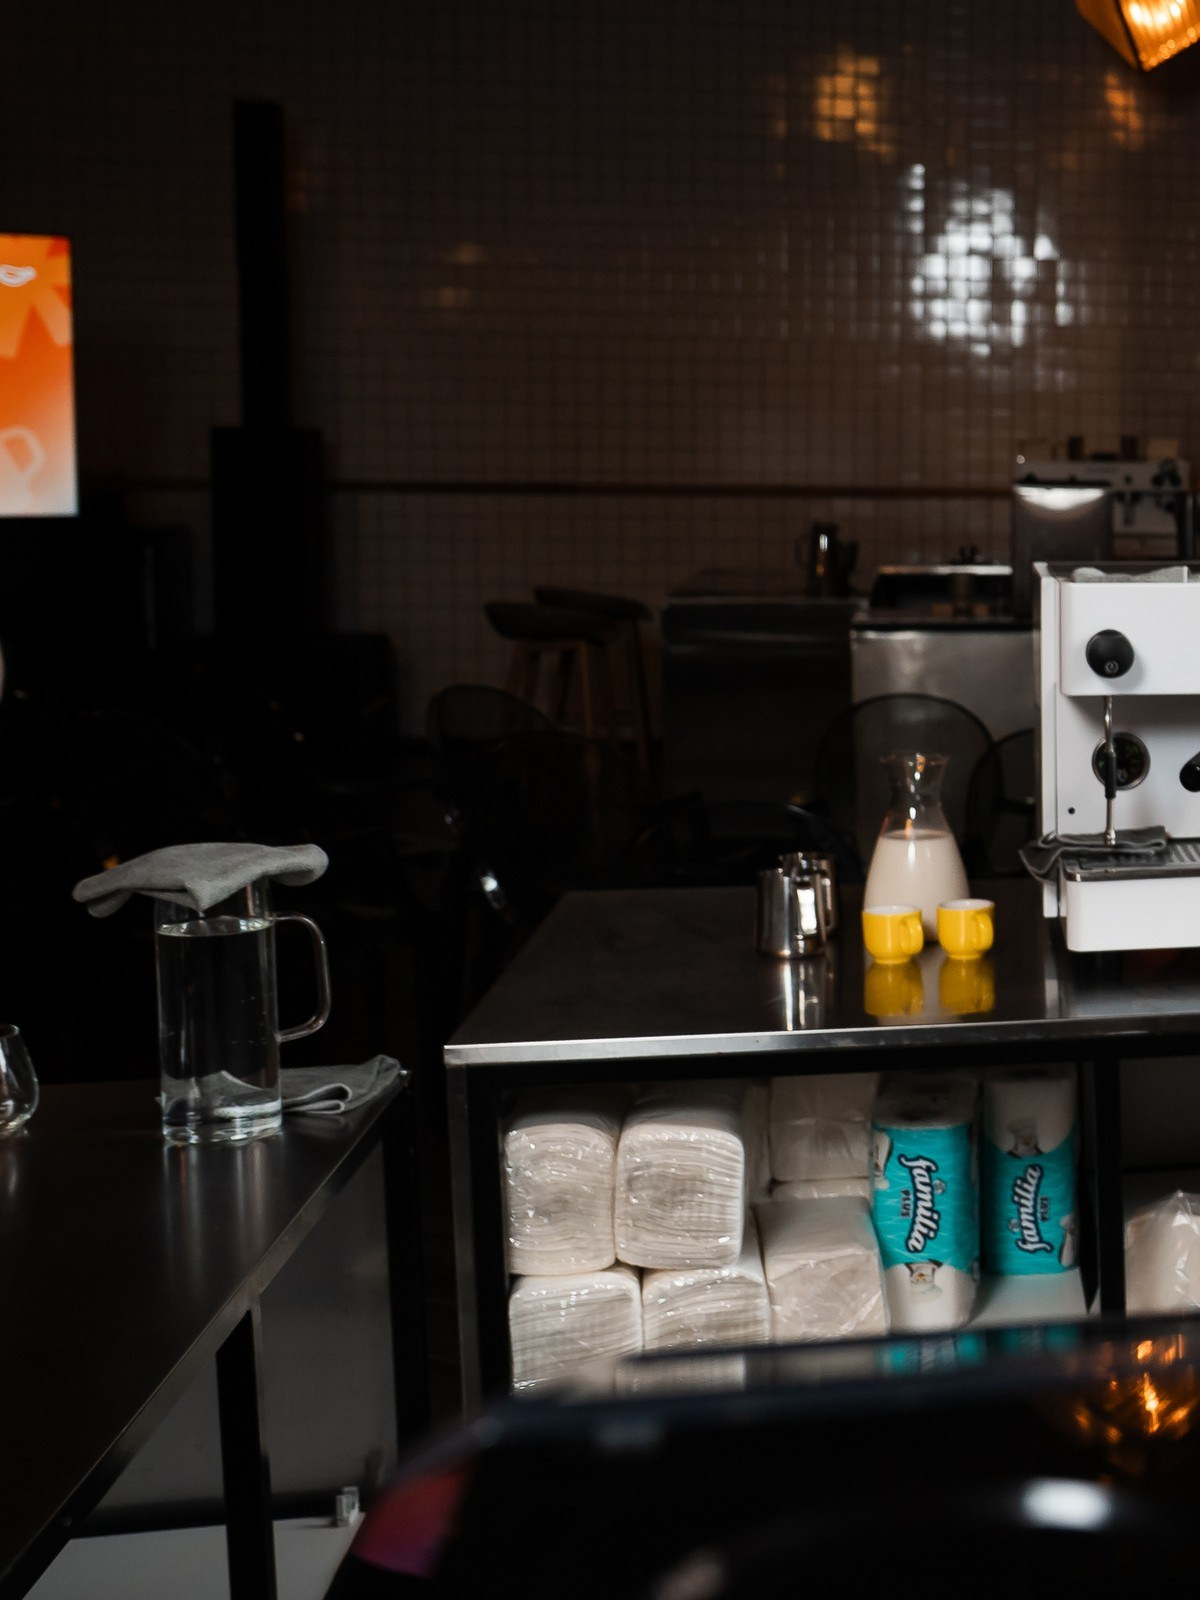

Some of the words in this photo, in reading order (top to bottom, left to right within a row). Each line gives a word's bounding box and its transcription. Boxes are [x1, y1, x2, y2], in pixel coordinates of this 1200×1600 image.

[898, 1155, 940, 1252] familia
[900, 1188, 912, 1218] PLUS
[1013, 1165, 1053, 1252] familia
